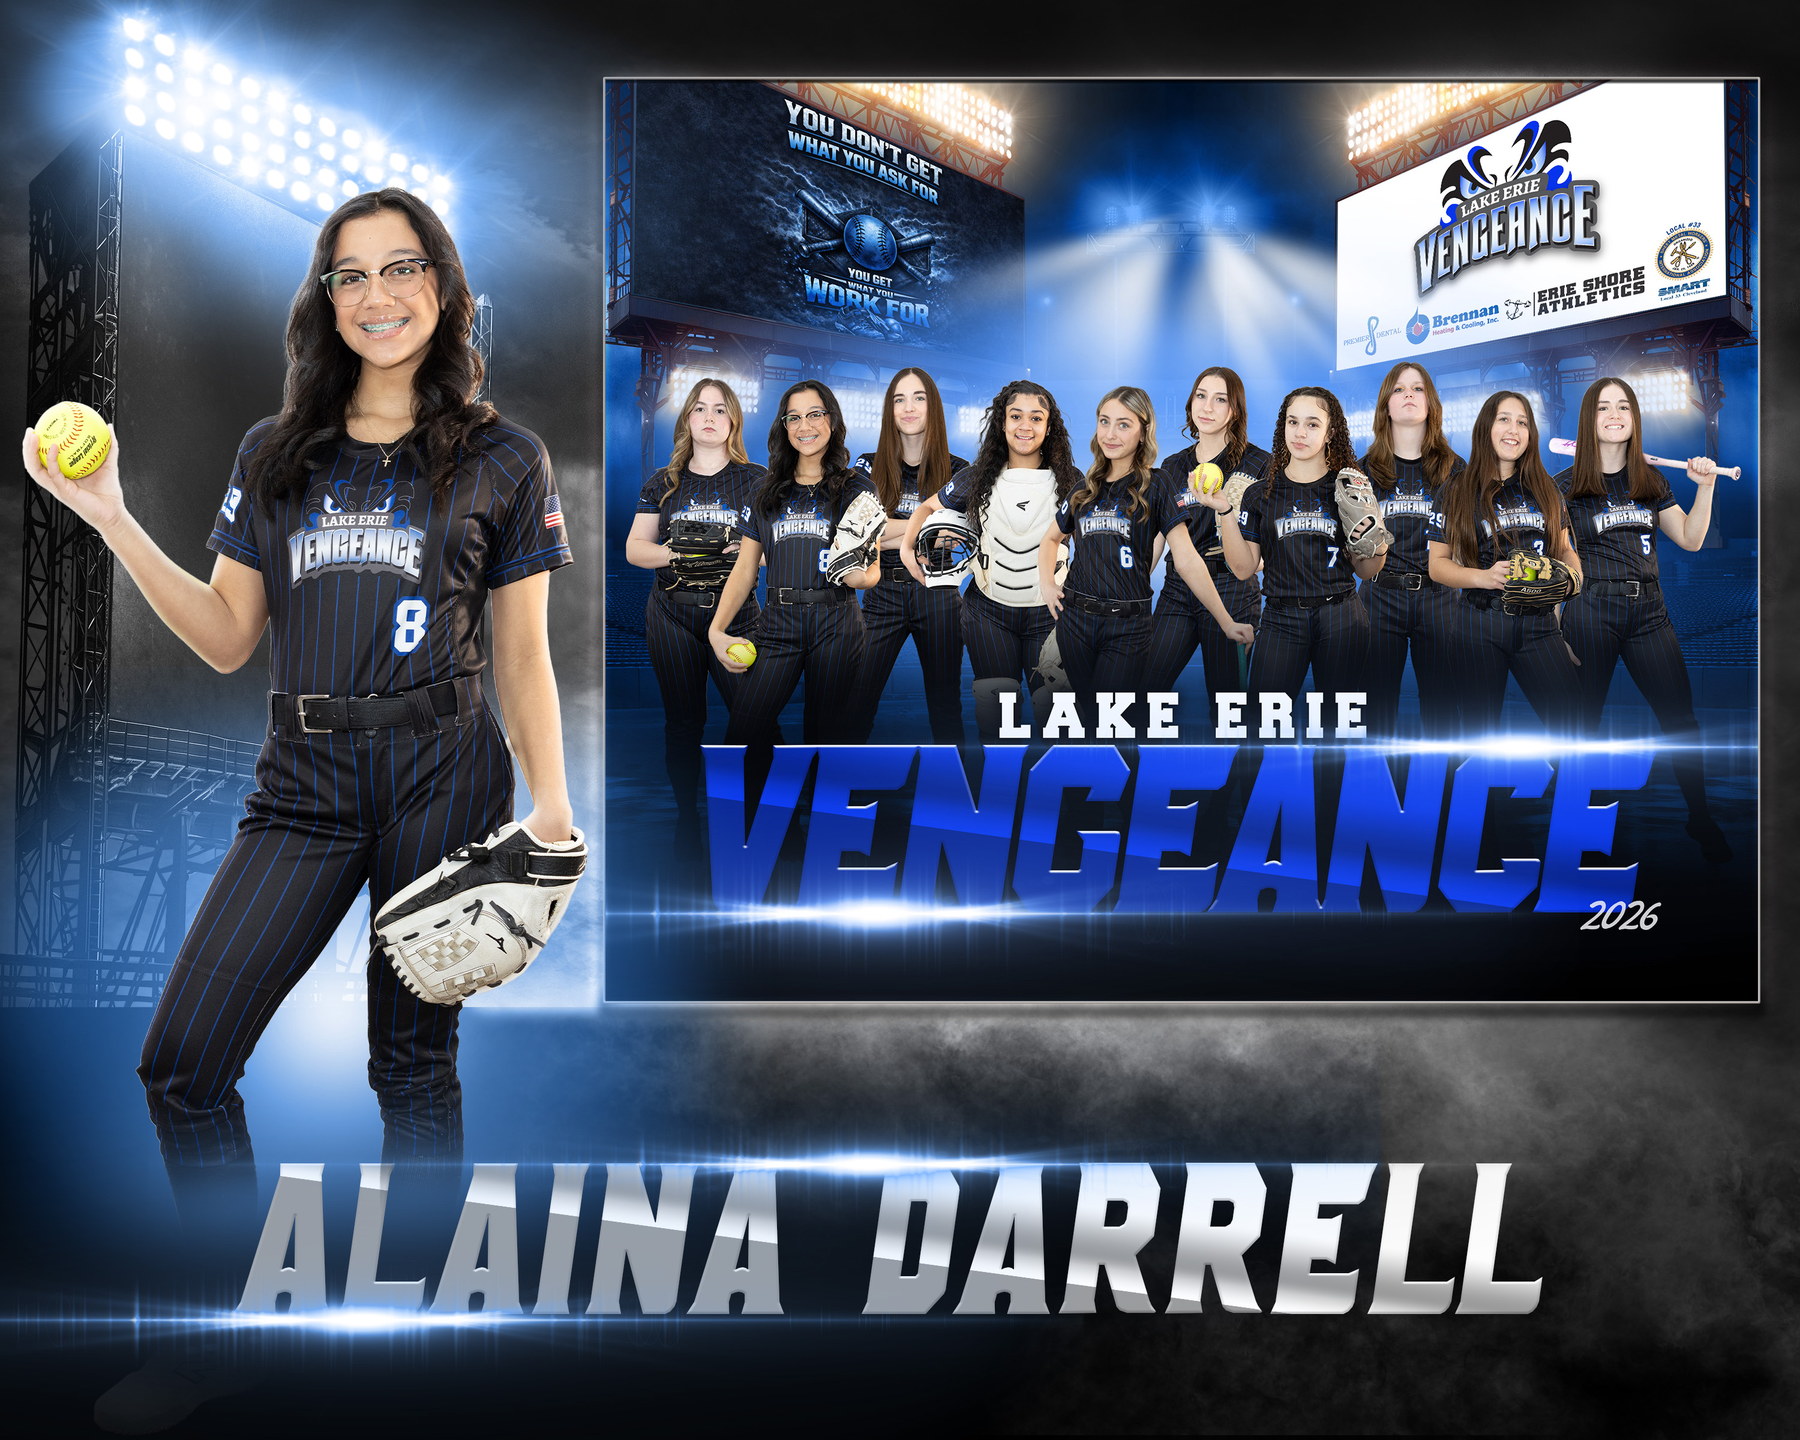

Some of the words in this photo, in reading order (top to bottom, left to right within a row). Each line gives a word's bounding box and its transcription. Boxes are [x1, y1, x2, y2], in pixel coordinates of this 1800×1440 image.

[784, 98, 834, 137] YOU
[841, 122, 902, 165] DON'T
[906, 153, 943, 186] GET
[787, 130, 839, 161] WHAT
[843, 149, 875, 173] YOU
[878, 162, 908, 190] ASK
[911, 178, 939, 205] FOR
[1460, 191, 1500, 218] LAKE
[1503, 178, 1541, 200] ERIE
[1417, 184, 1596, 293] VENGEANCE
[1666, 224, 1685, 235] LOCAL
[847, 267, 870, 281] YOU
[872, 274, 893, 288] GET
[847, 280, 875, 294] WHAT
[876, 288, 895, 299] YOU
[1537, 282, 1576, 303] ERIE
[1583, 265, 1645, 293] SHORE
[1658, 278, 1710, 296] SMART
[803, 273, 881, 315] WORK
[886, 298, 930, 329] FOR
[1537, 280, 1645, 316] ATHLETICS
[1432, 304, 1500, 329] Brennan
[1343, 334, 1370, 346] PREMIER
[1376, 327, 1402, 339] DENTAL
[1432, 326, 1455, 336] Heating
[1378, 499, 1434, 518] VENGEANC
[321, 516, 356, 527] LAKE
[358, 515, 389, 526] ERIE
[772, 519, 831, 543] VENGEANCE
[1078, 517, 1132, 538] VENGEANCE
[1274, 517, 1338, 540] VENGEANCE
[1593, 509, 1653, 535] VENGEANCE
[288, 527, 424, 583] VENGEANCE
[1640, 534, 1651, 555] 5
[1119, 545, 1133, 569] 6
[1327, 546, 1340, 568] 7
[392, 598, 429, 654] 8
